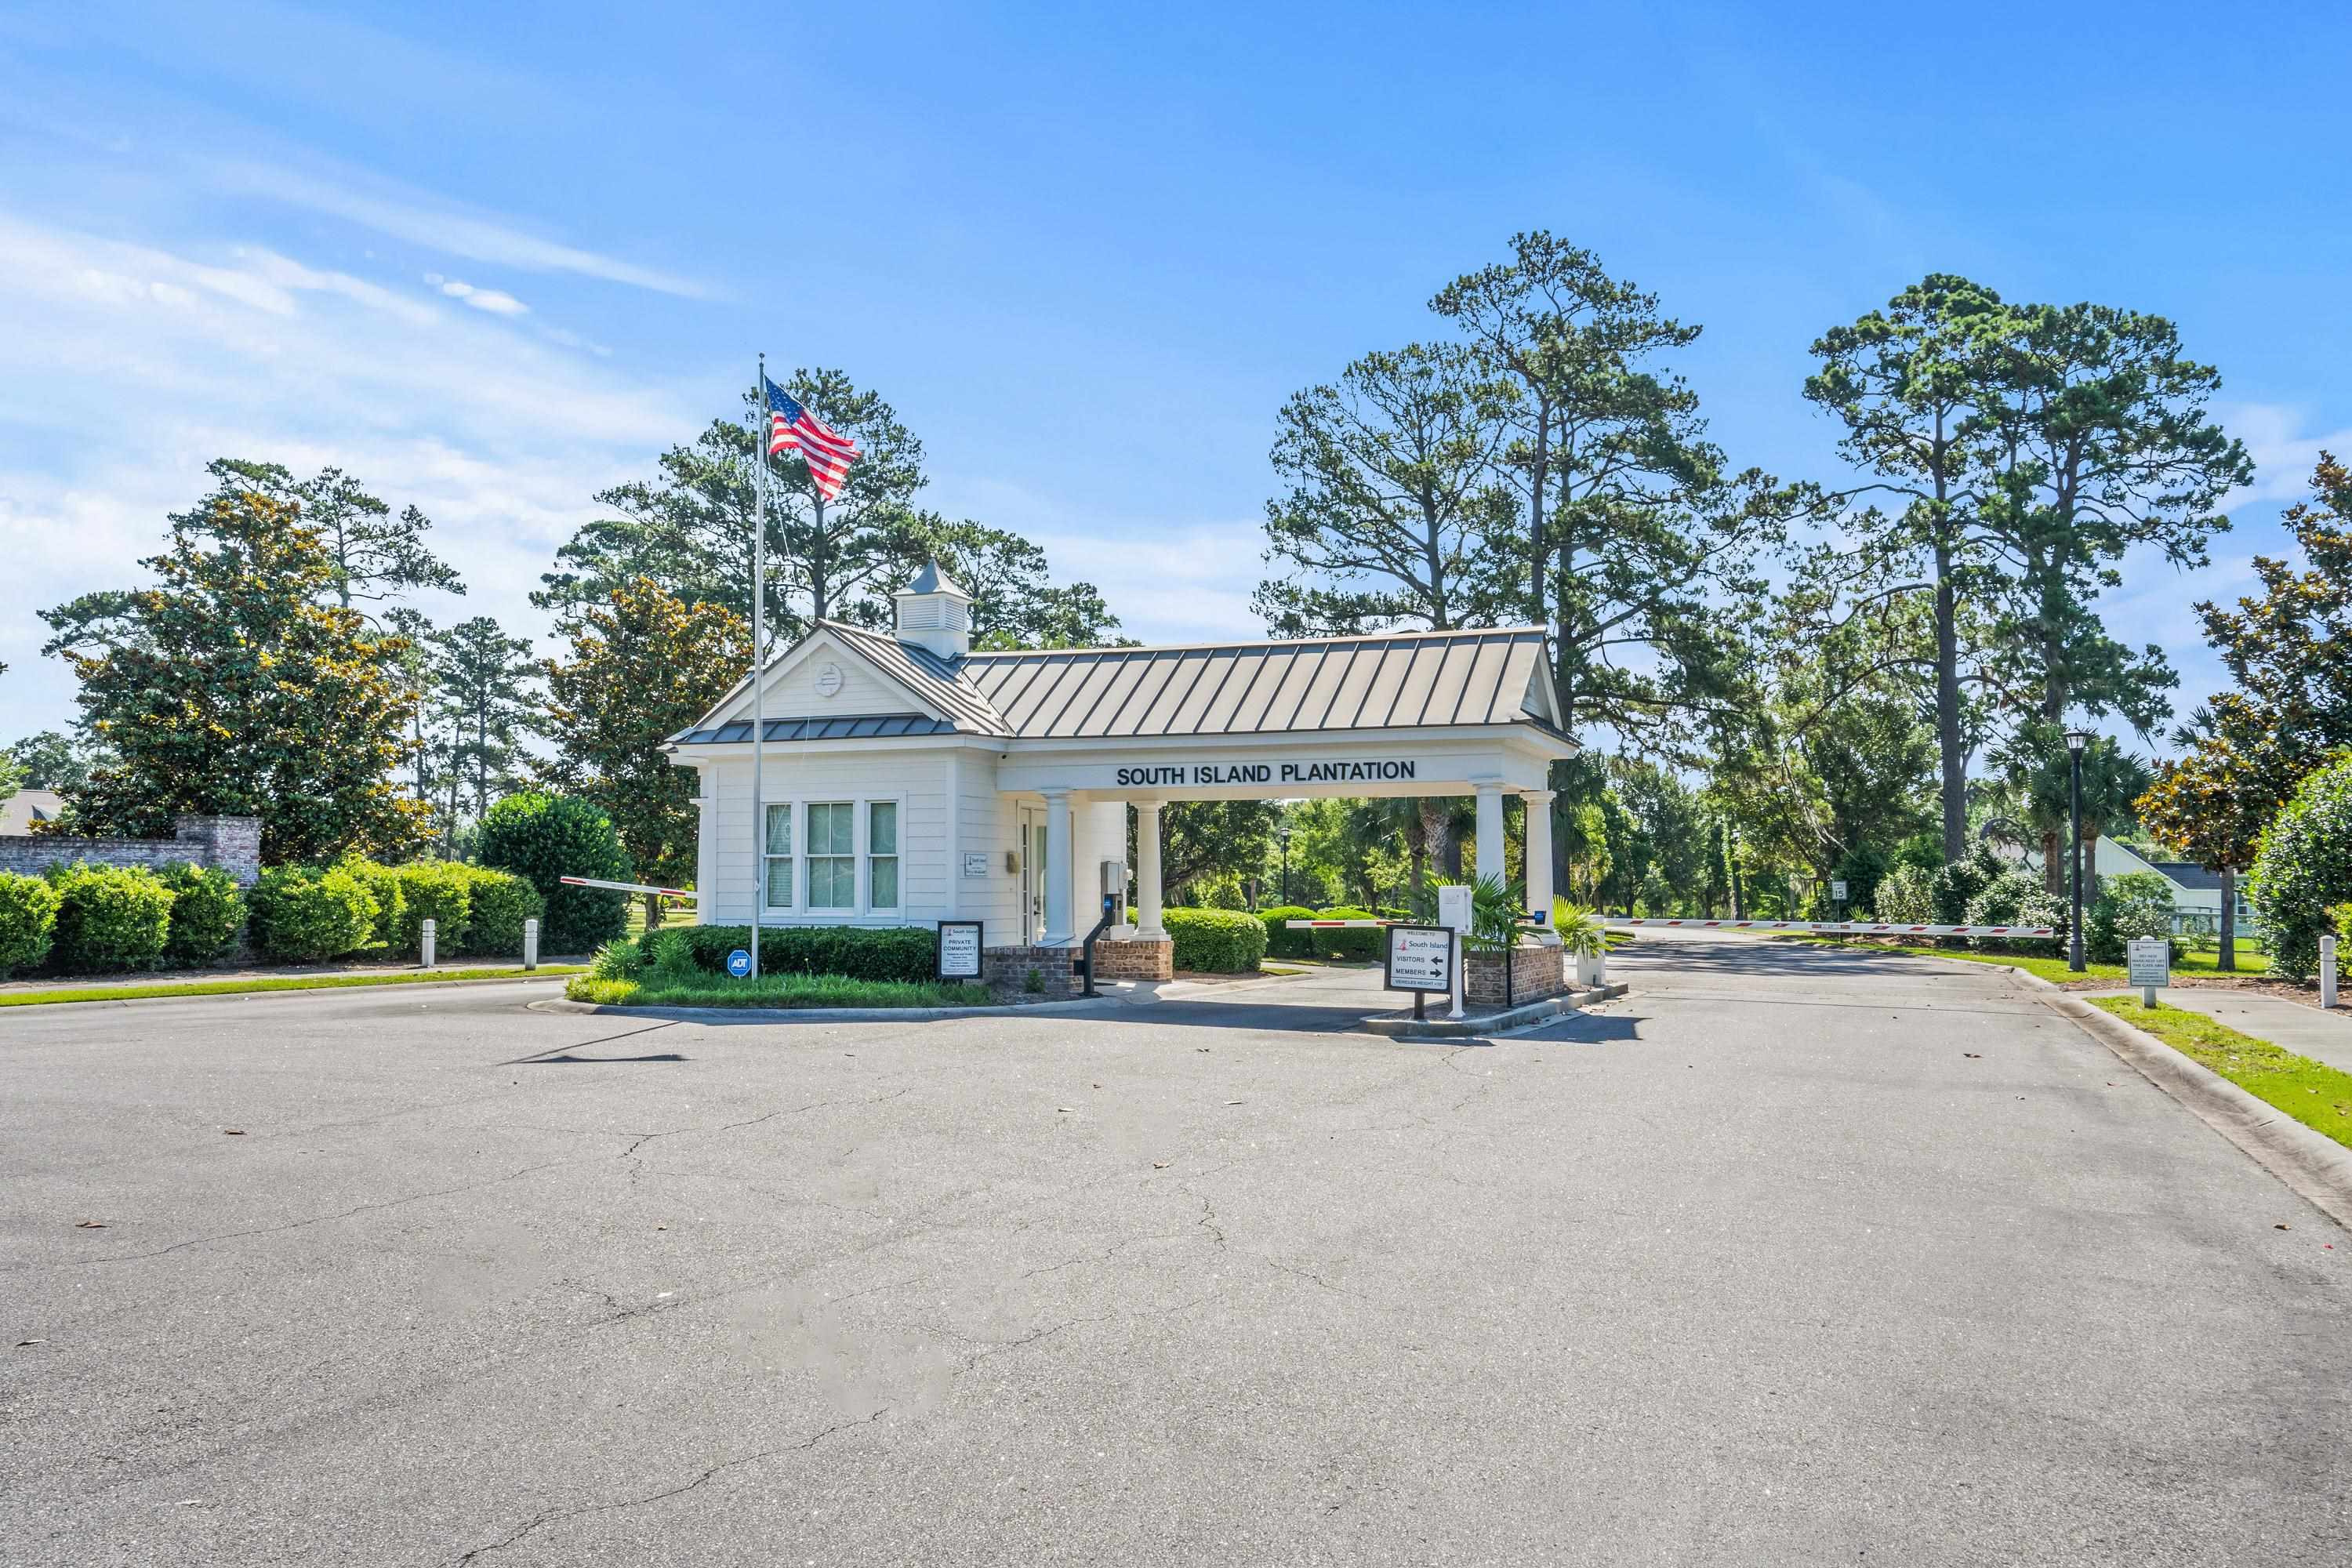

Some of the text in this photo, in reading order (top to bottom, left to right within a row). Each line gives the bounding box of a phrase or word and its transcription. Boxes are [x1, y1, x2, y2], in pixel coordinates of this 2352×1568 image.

[1117, 760, 1415, 785] SOUTH ISLAND PLANTATION
[731, 958, 747, 968] ADT
